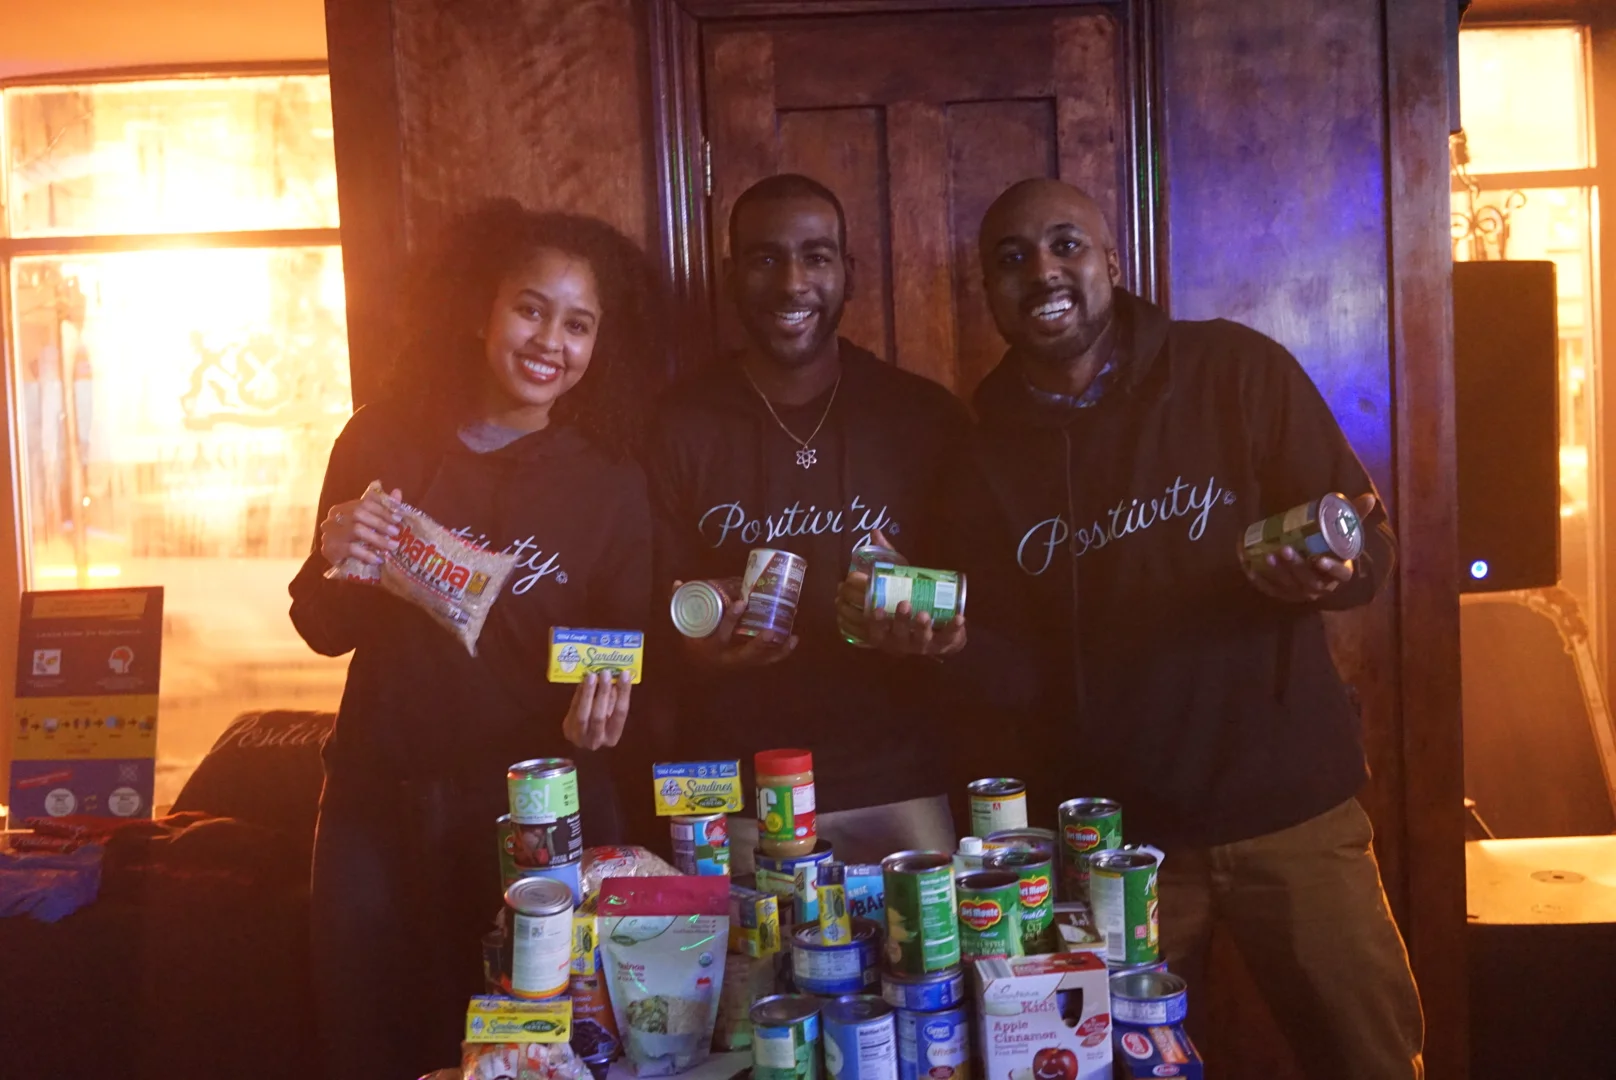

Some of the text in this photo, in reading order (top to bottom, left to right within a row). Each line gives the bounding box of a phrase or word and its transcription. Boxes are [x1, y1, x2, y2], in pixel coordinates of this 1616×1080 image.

[698, 495, 891, 552] Positivity
[1017, 476, 1222, 576] Positivity
[581, 646, 634, 667] Sardines
[683, 779, 733, 800] Sardines
[1076, 832, 1097, 842] Monte
[1029, 884, 1048, 895] Monte
[973, 907, 998, 918] Monte
[1020, 1000, 1056, 1014] Kids
[993, 1020, 1029, 1033] Apple
[993, 1031, 1057, 1044] Cinnamon
